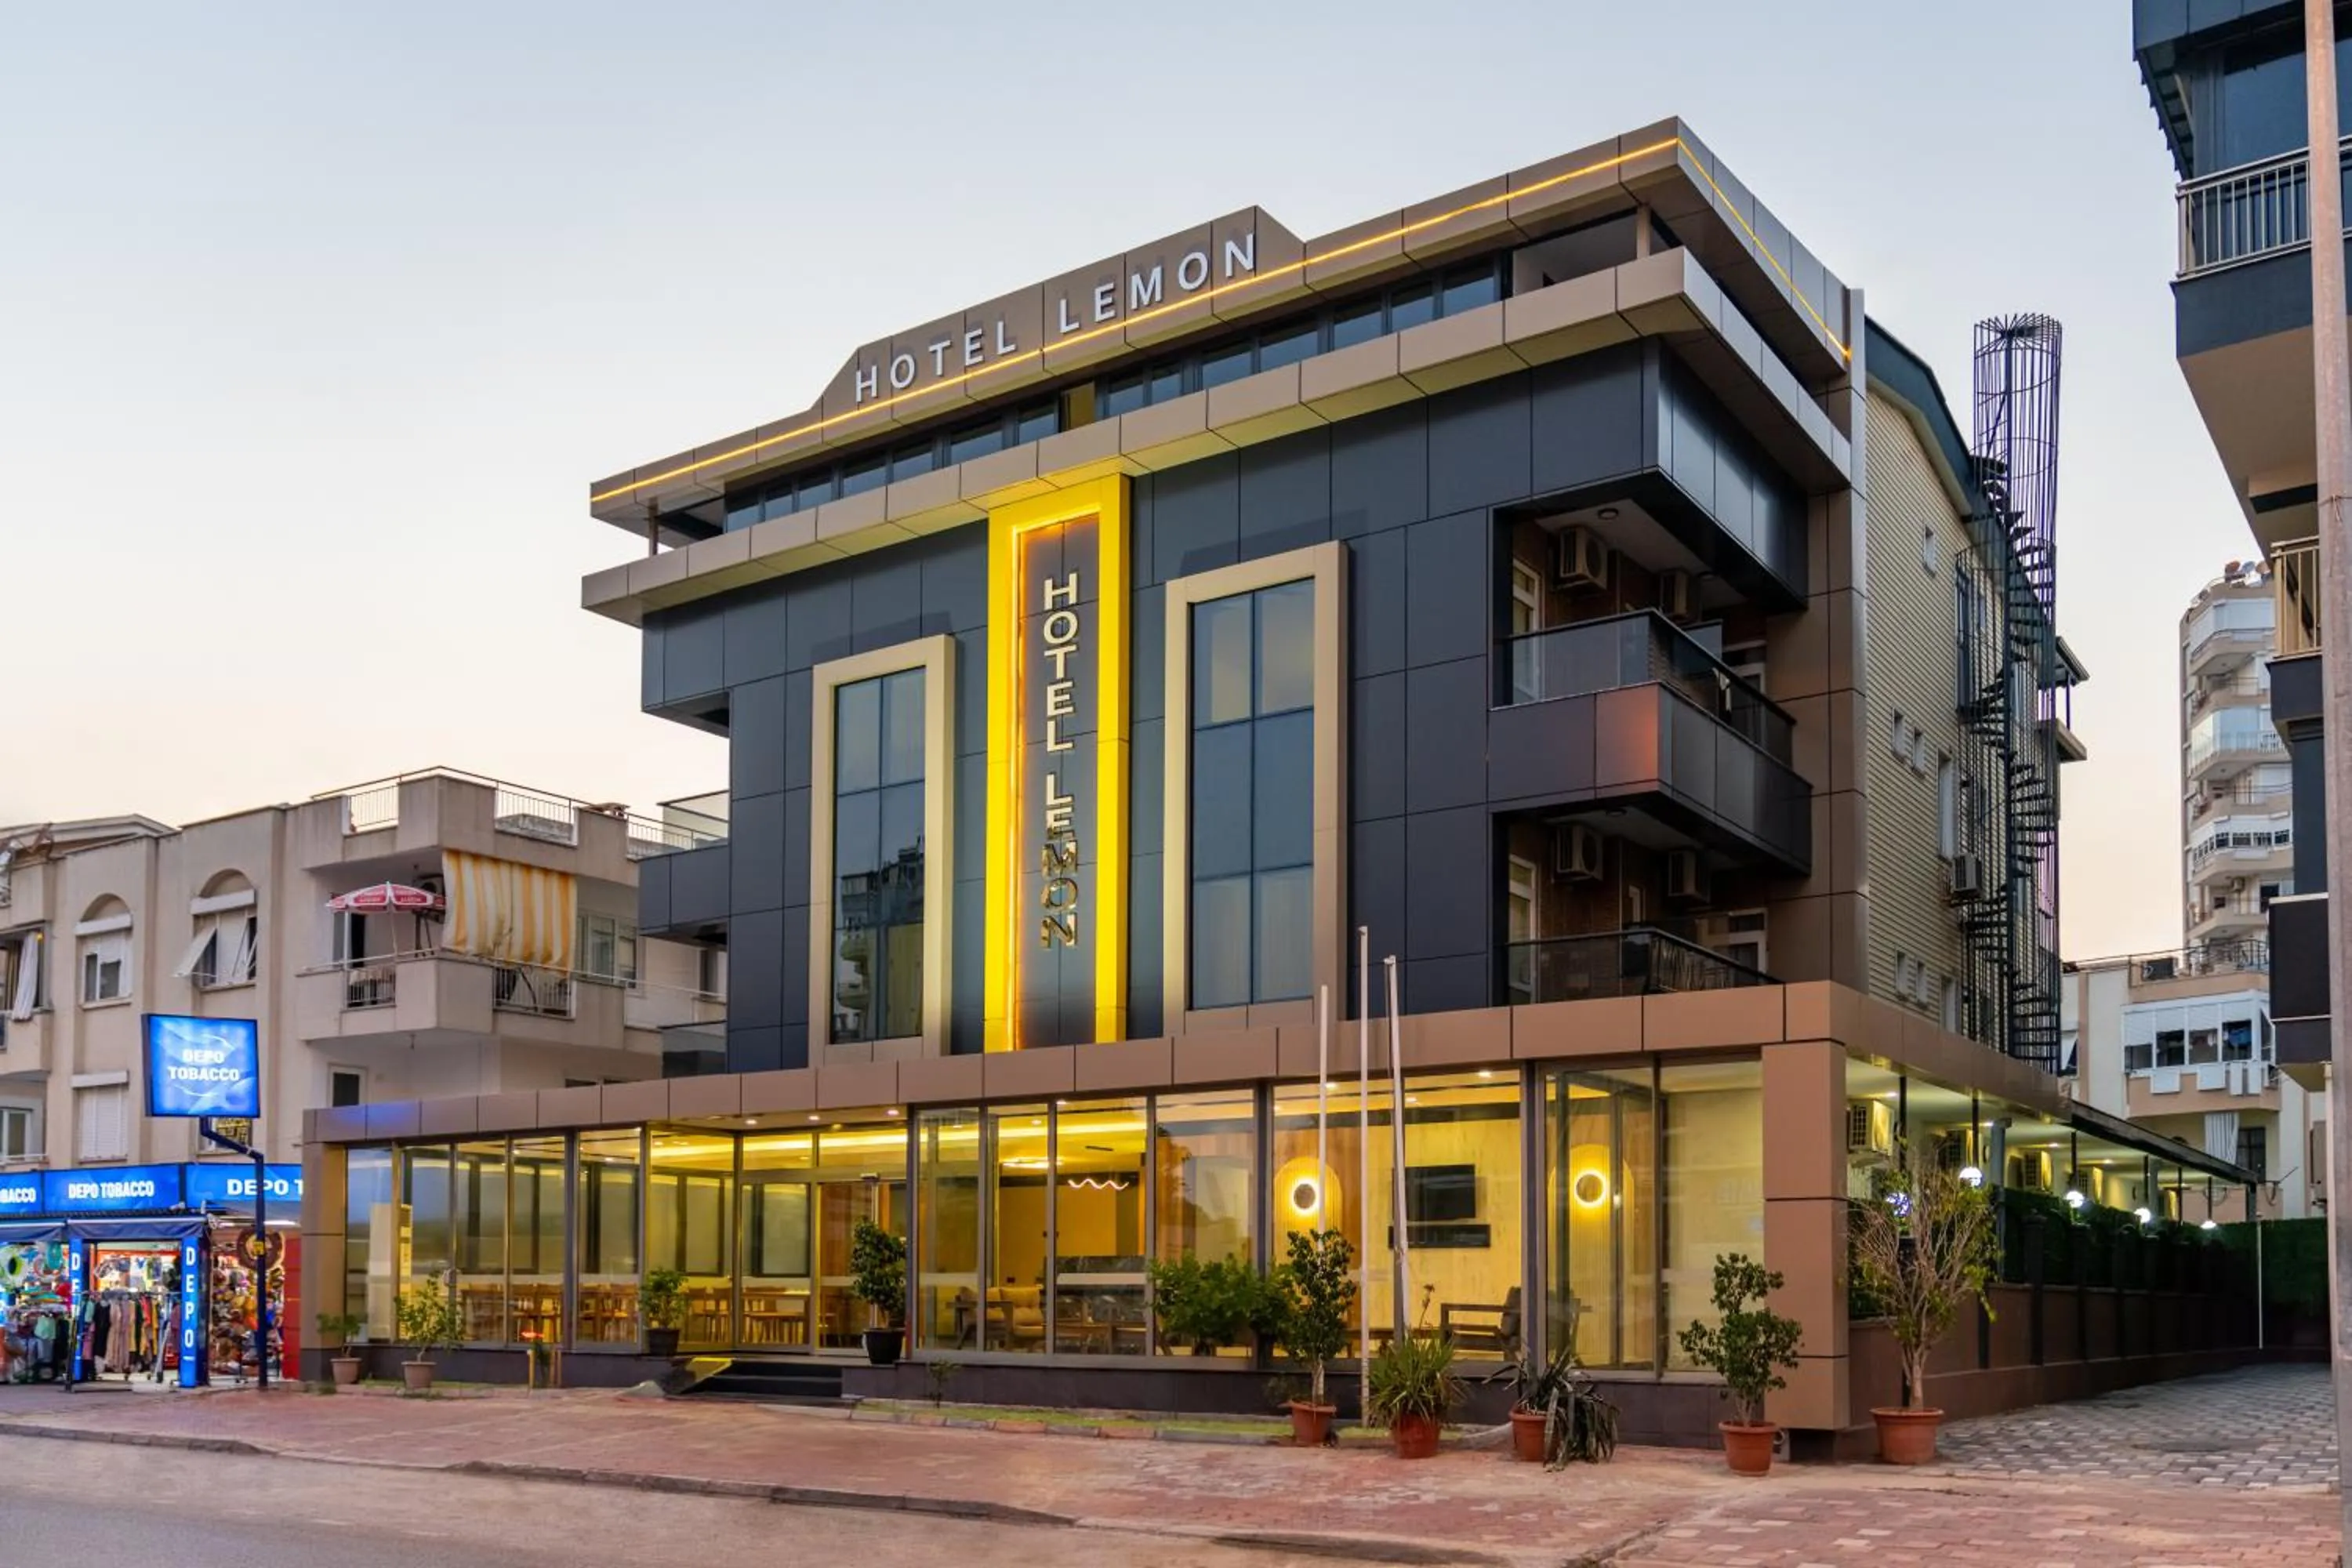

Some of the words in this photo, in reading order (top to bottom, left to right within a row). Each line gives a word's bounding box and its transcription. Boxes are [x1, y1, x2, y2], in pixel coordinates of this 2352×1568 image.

[855, 320, 1017, 403] HOTEL
[1058, 232, 1256, 334] LEMON
[1044, 572, 1079, 753] HOTEL
[1040, 772, 1079, 949] LEMON
[167, 1066, 239, 1081] TOBACCO
[182, 1048, 225, 1064] DEPO
[0, 1187, 37, 1203] BACCO
[68, 1182, 99, 1199] DEPO
[100, 1181, 154, 1198] TOBACCO
[184, 1246, 196, 1348] DEPO
